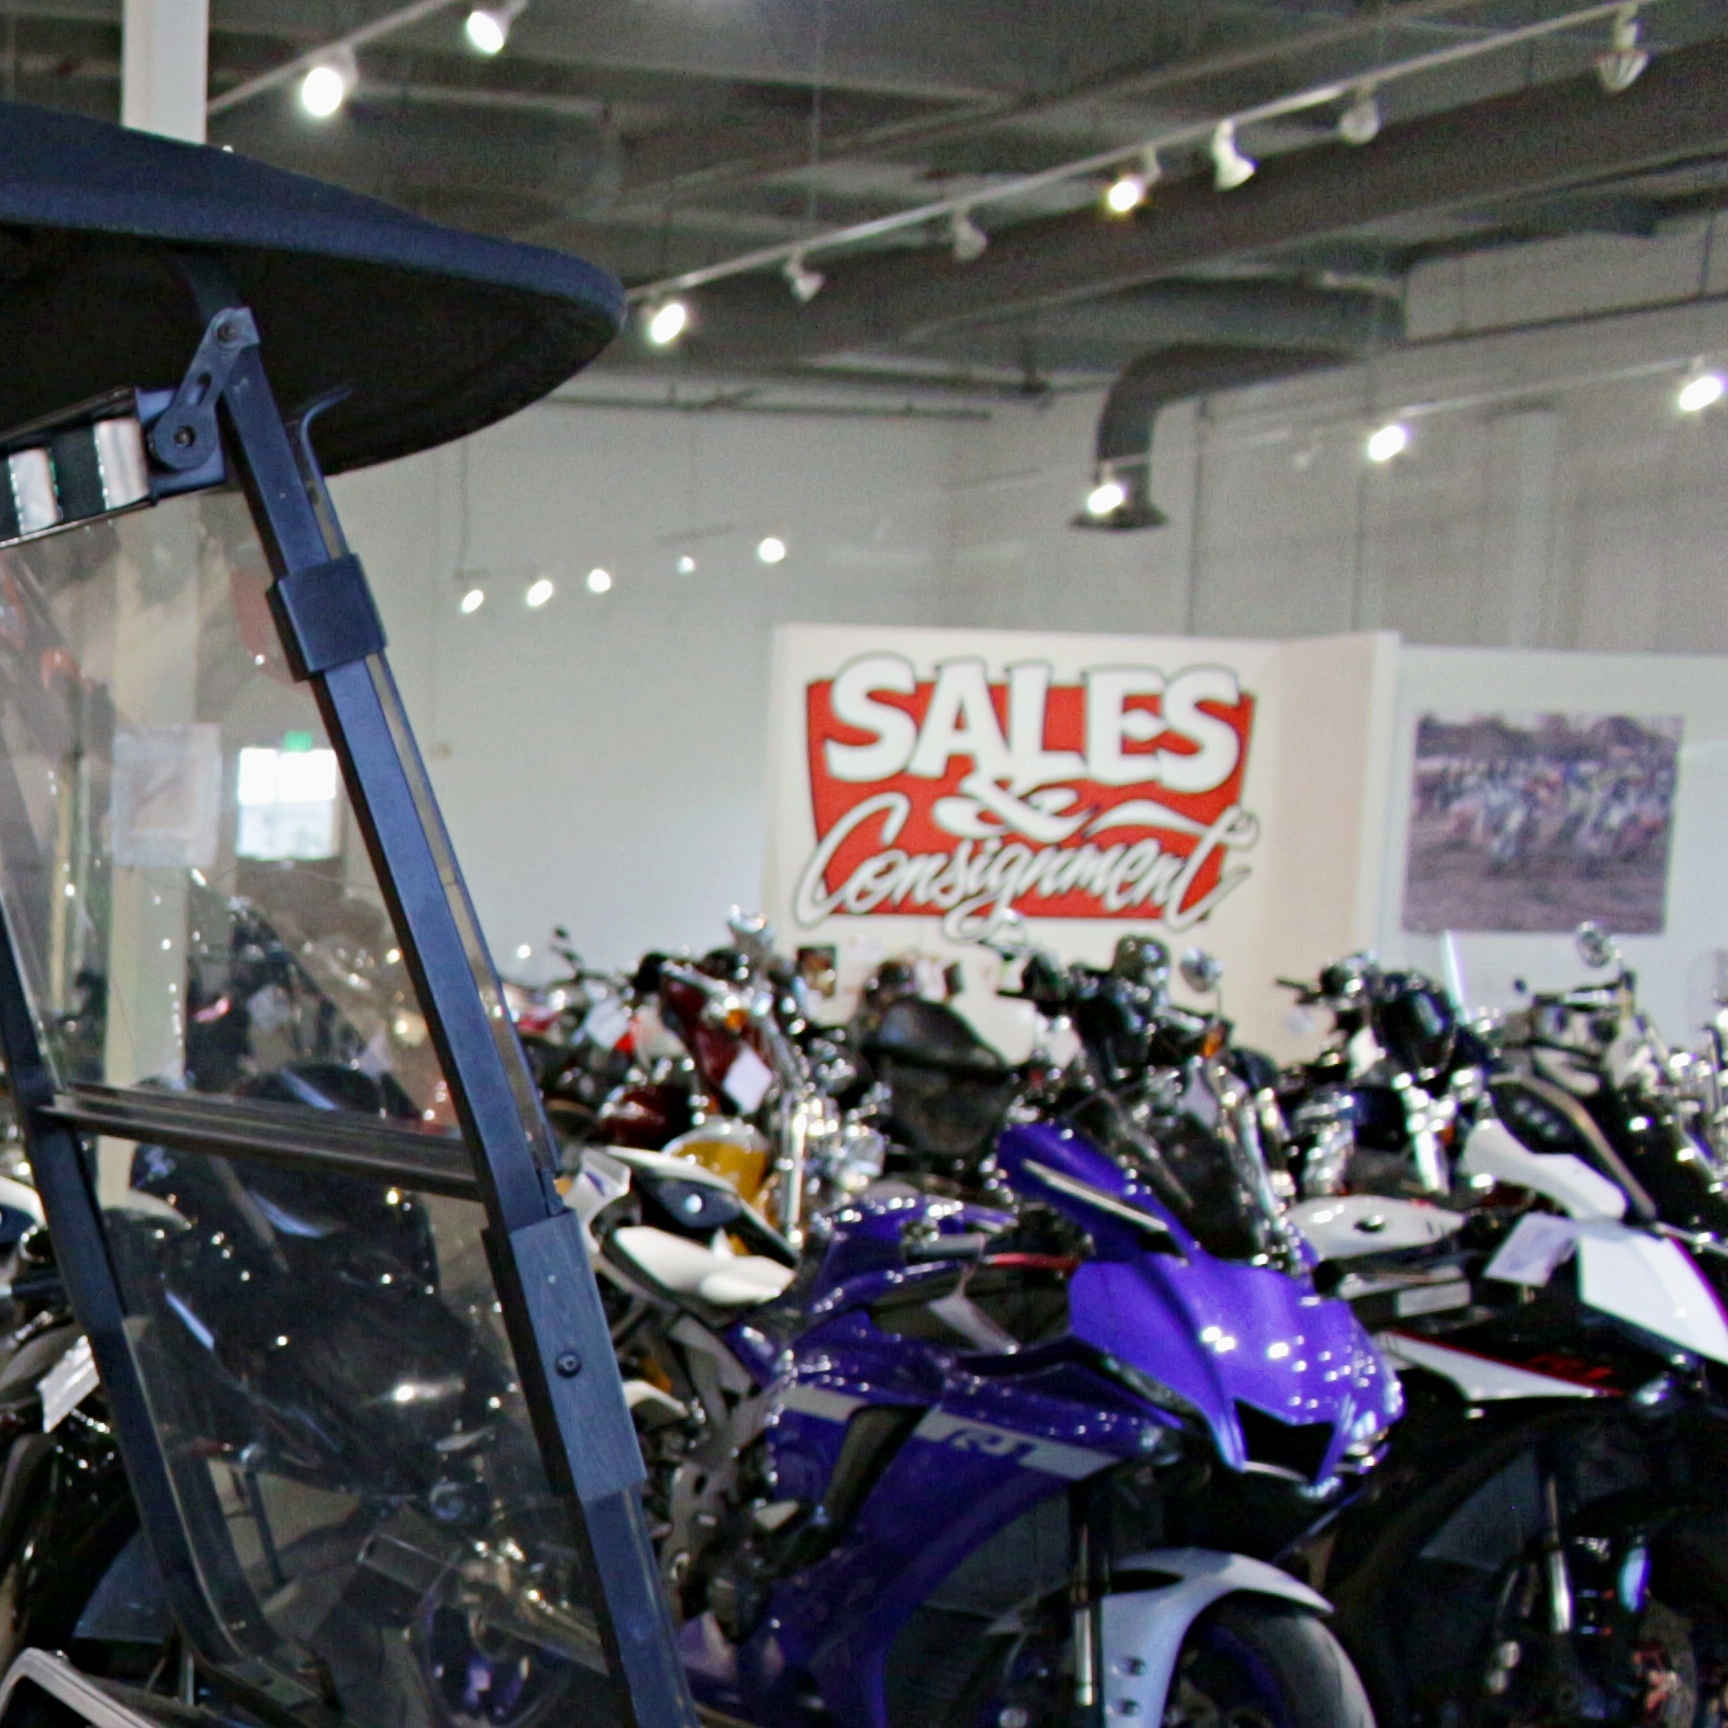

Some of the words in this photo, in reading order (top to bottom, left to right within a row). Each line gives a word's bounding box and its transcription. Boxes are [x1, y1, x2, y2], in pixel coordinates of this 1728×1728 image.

[824, 650, 1242, 794] SALES
[794, 791, 1259, 941] Consignment
[931, 768, 1098, 842] &
